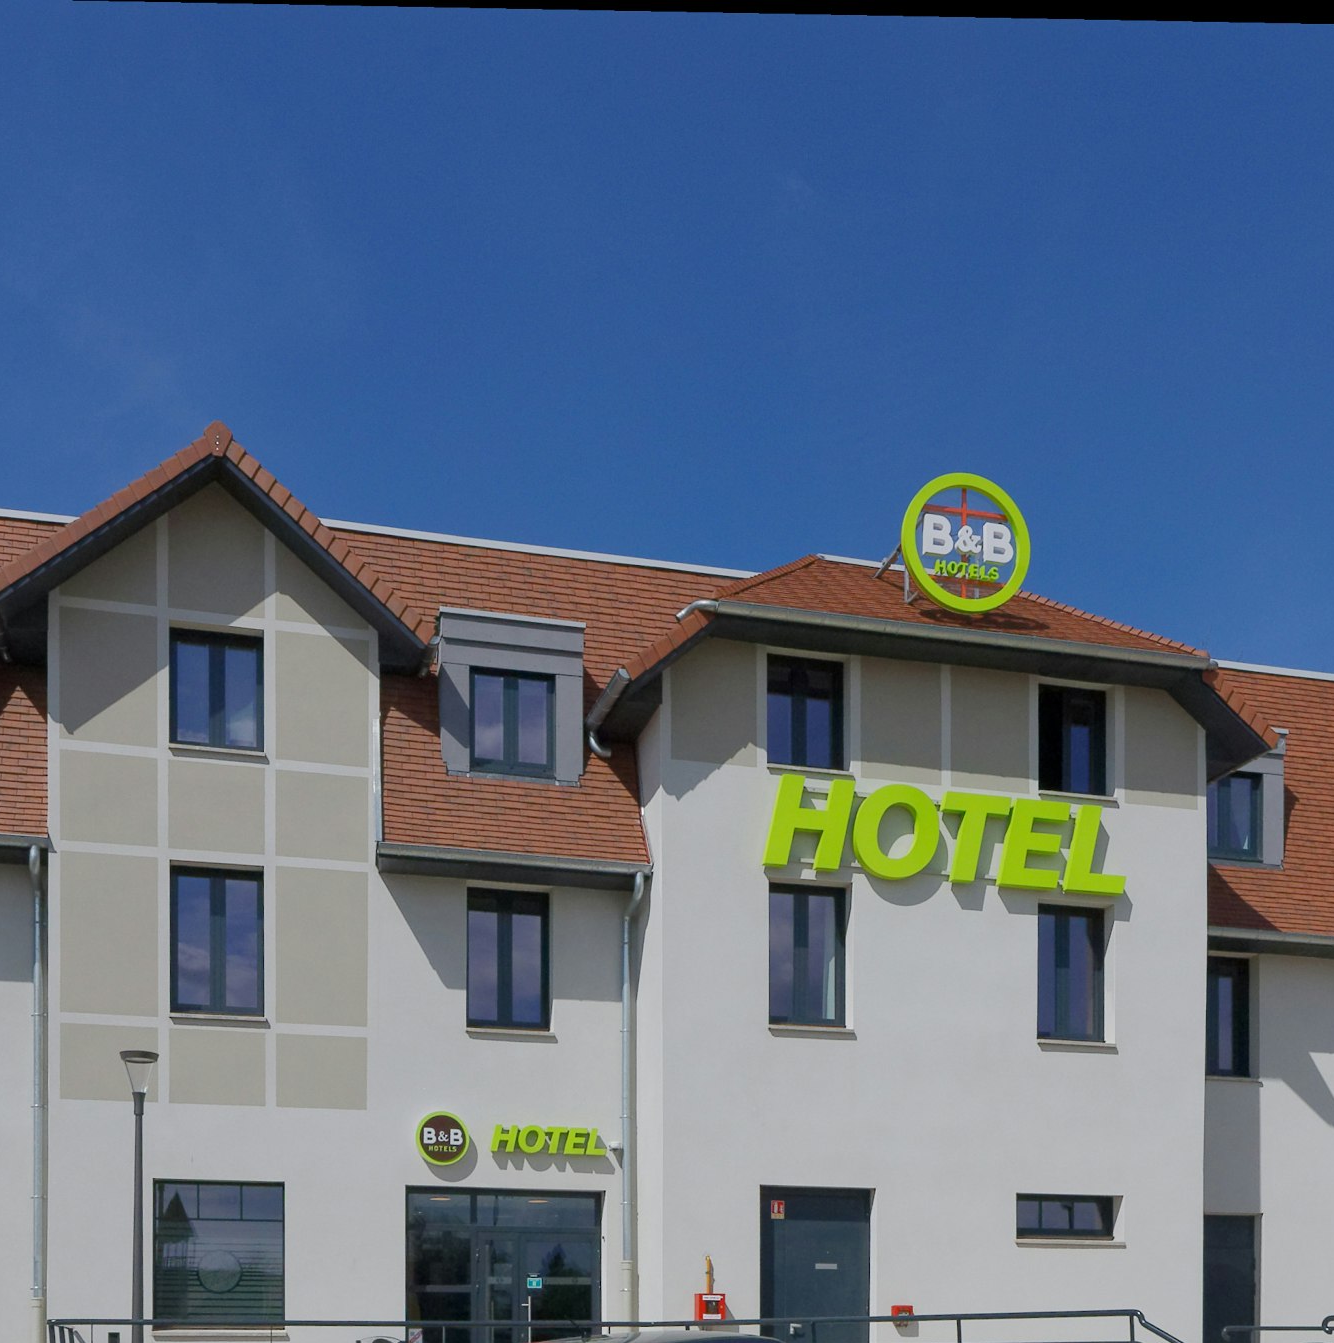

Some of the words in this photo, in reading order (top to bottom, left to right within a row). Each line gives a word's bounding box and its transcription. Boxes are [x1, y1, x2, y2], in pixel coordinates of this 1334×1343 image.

[922, 513, 1014, 564] B&B
[934, 559, 1000, 582] HOTELS
[763, 773, 1127, 895] HOTEL
[423, 1127, 464, 1146] B&B
[490, 1124, 607, 1156] HOTEL
